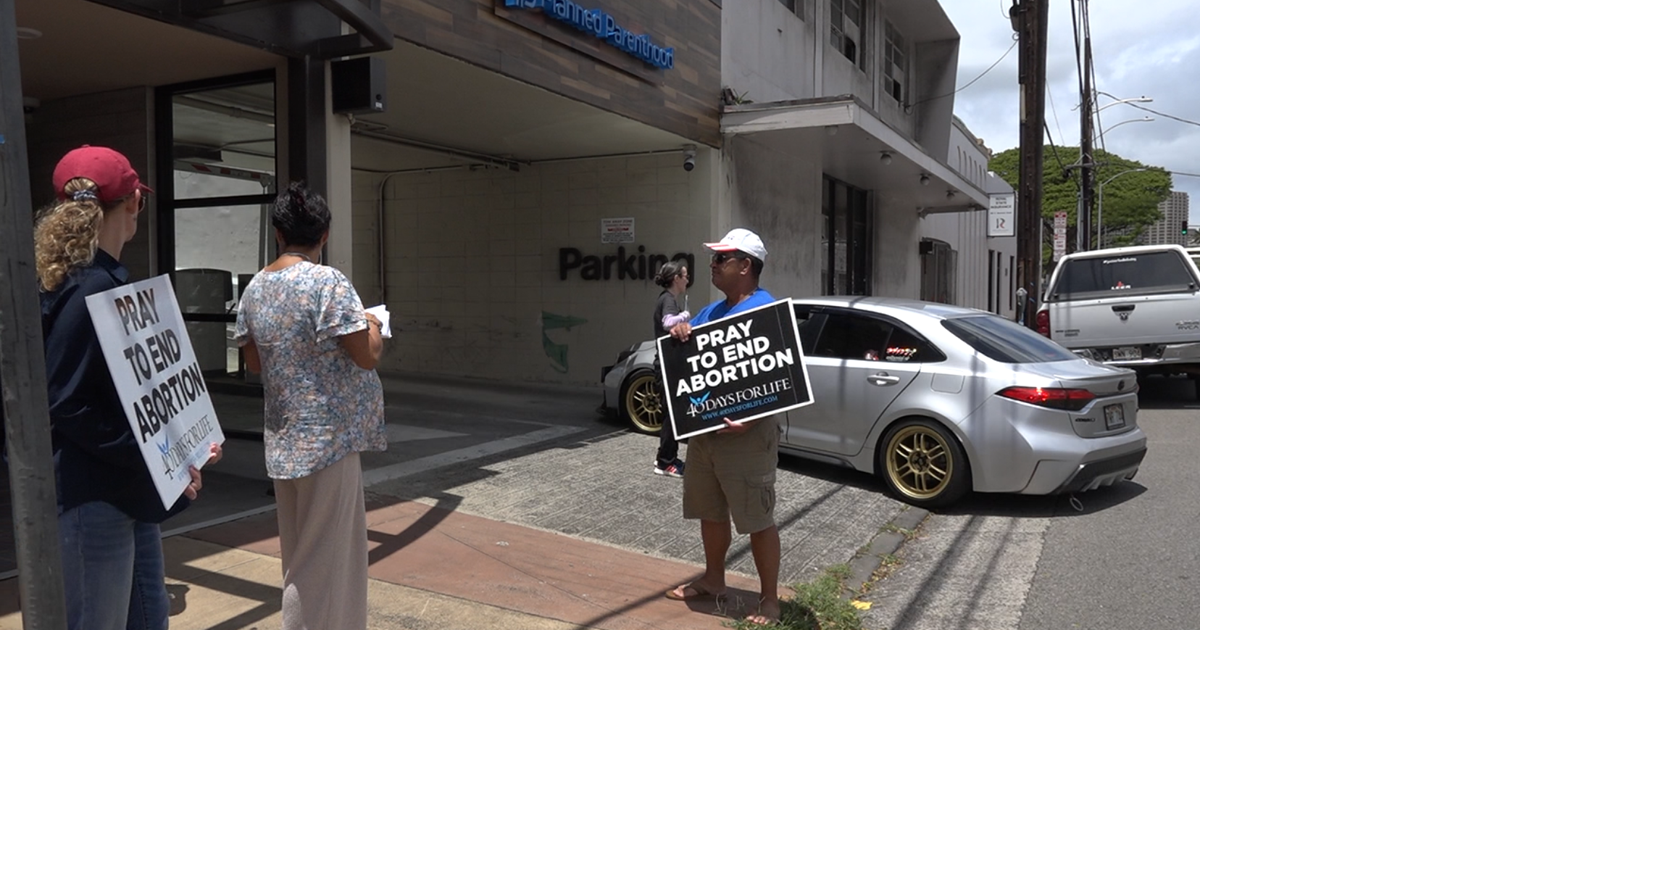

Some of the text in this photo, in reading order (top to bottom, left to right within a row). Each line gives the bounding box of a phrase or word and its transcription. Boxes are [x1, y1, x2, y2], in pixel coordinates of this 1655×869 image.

[605, 14, 674, 69] Parenthood
[114, 288, 159, 335] PRAY
[696, 319, 753, 351] PRAY
[123, 329, 181, 386] TO END
[676, 348, 794, 397] ABORTION
[686, 336, 770, 372] TO END
[133, 362, 205, 443] ABORTION
[686, 377, 792, 417] 40 DAYS FOR LIFE
